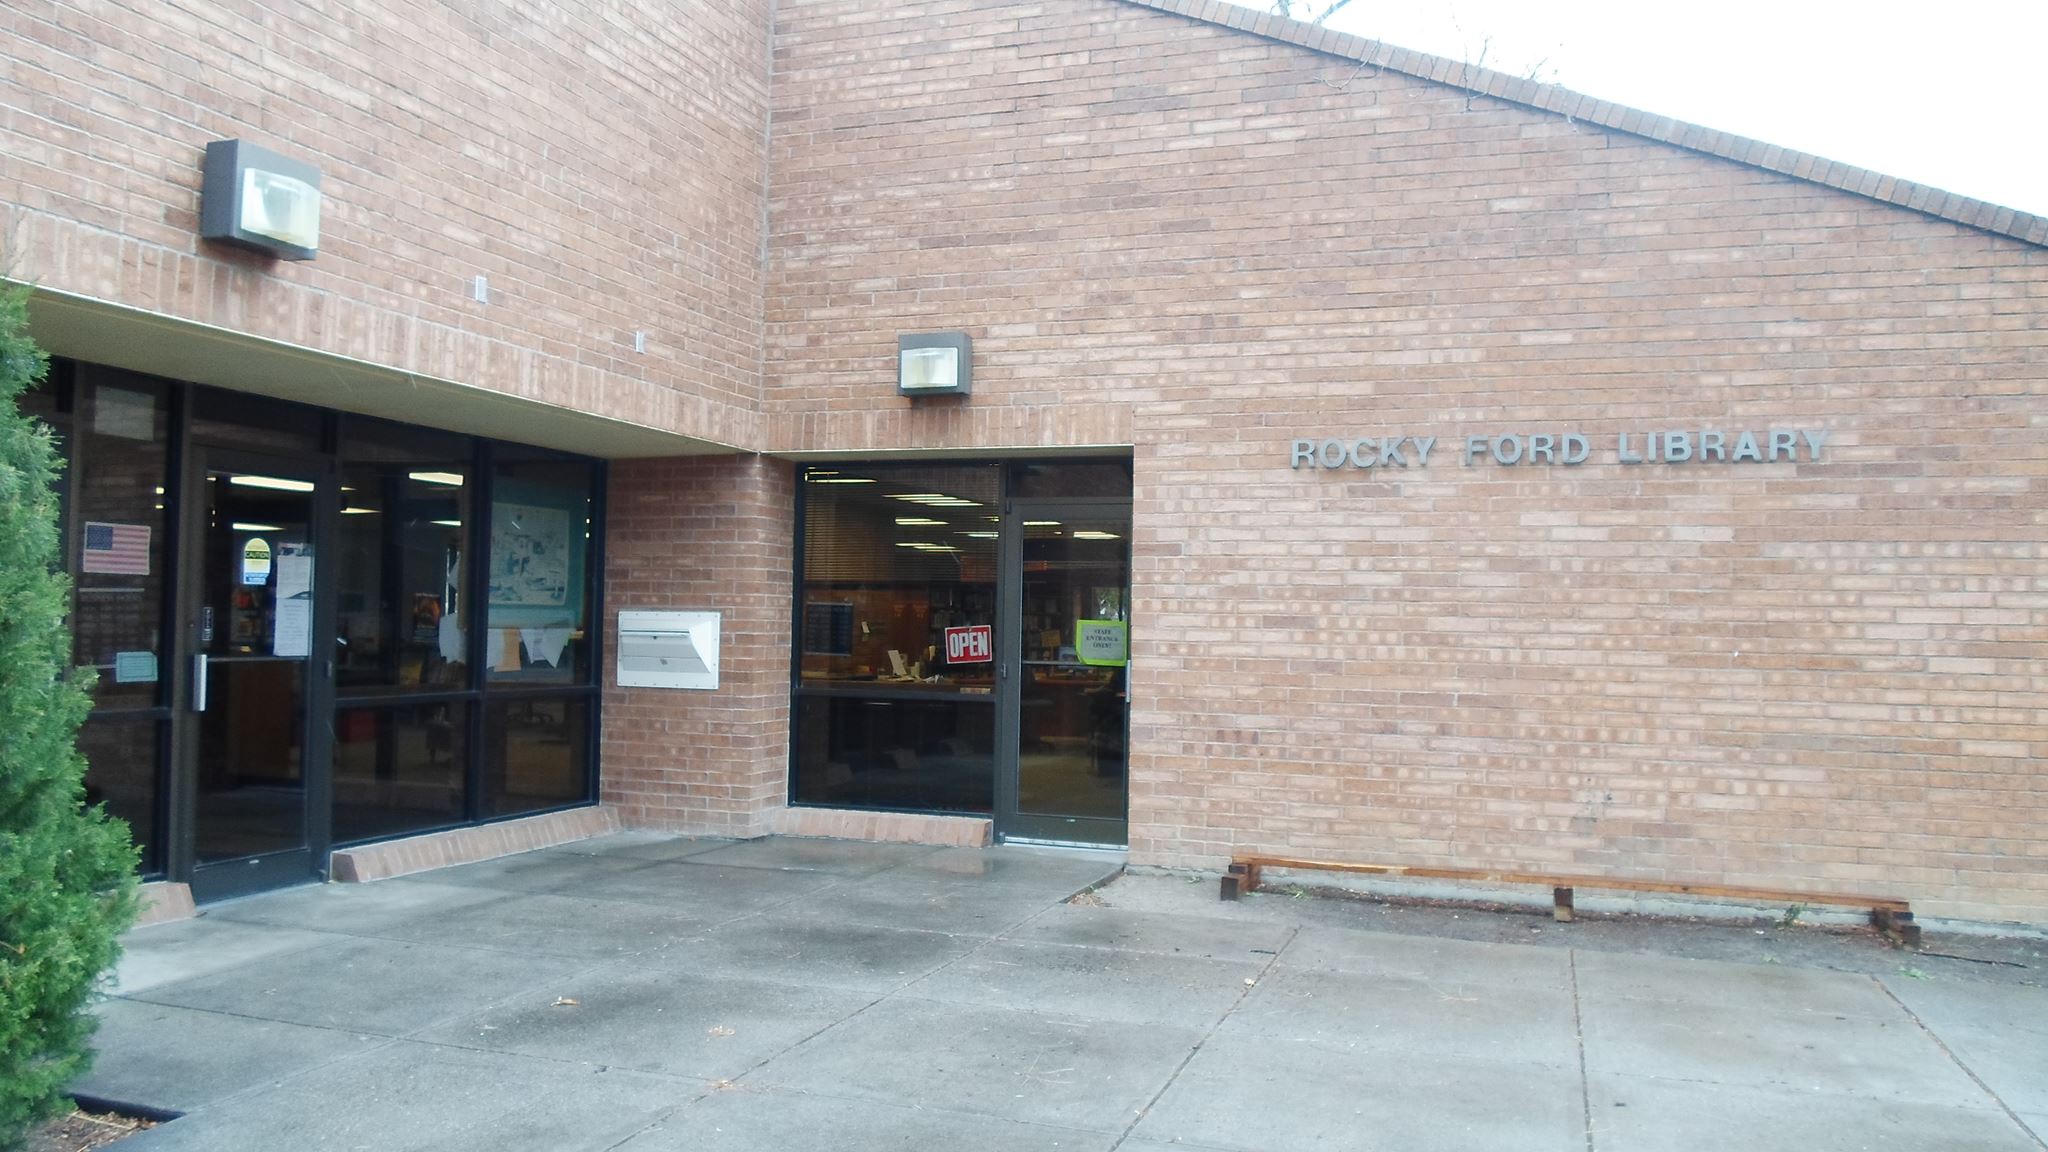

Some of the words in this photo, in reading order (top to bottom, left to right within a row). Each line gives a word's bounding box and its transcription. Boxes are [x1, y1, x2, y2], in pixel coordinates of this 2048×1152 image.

[1291, 436, 1437, 469] ROCKY
[1466, 432, 1591, 466] FORD
[1618, 428, 1830, 465] LIBRARY
[949, 631, 989, 658] OPEN
